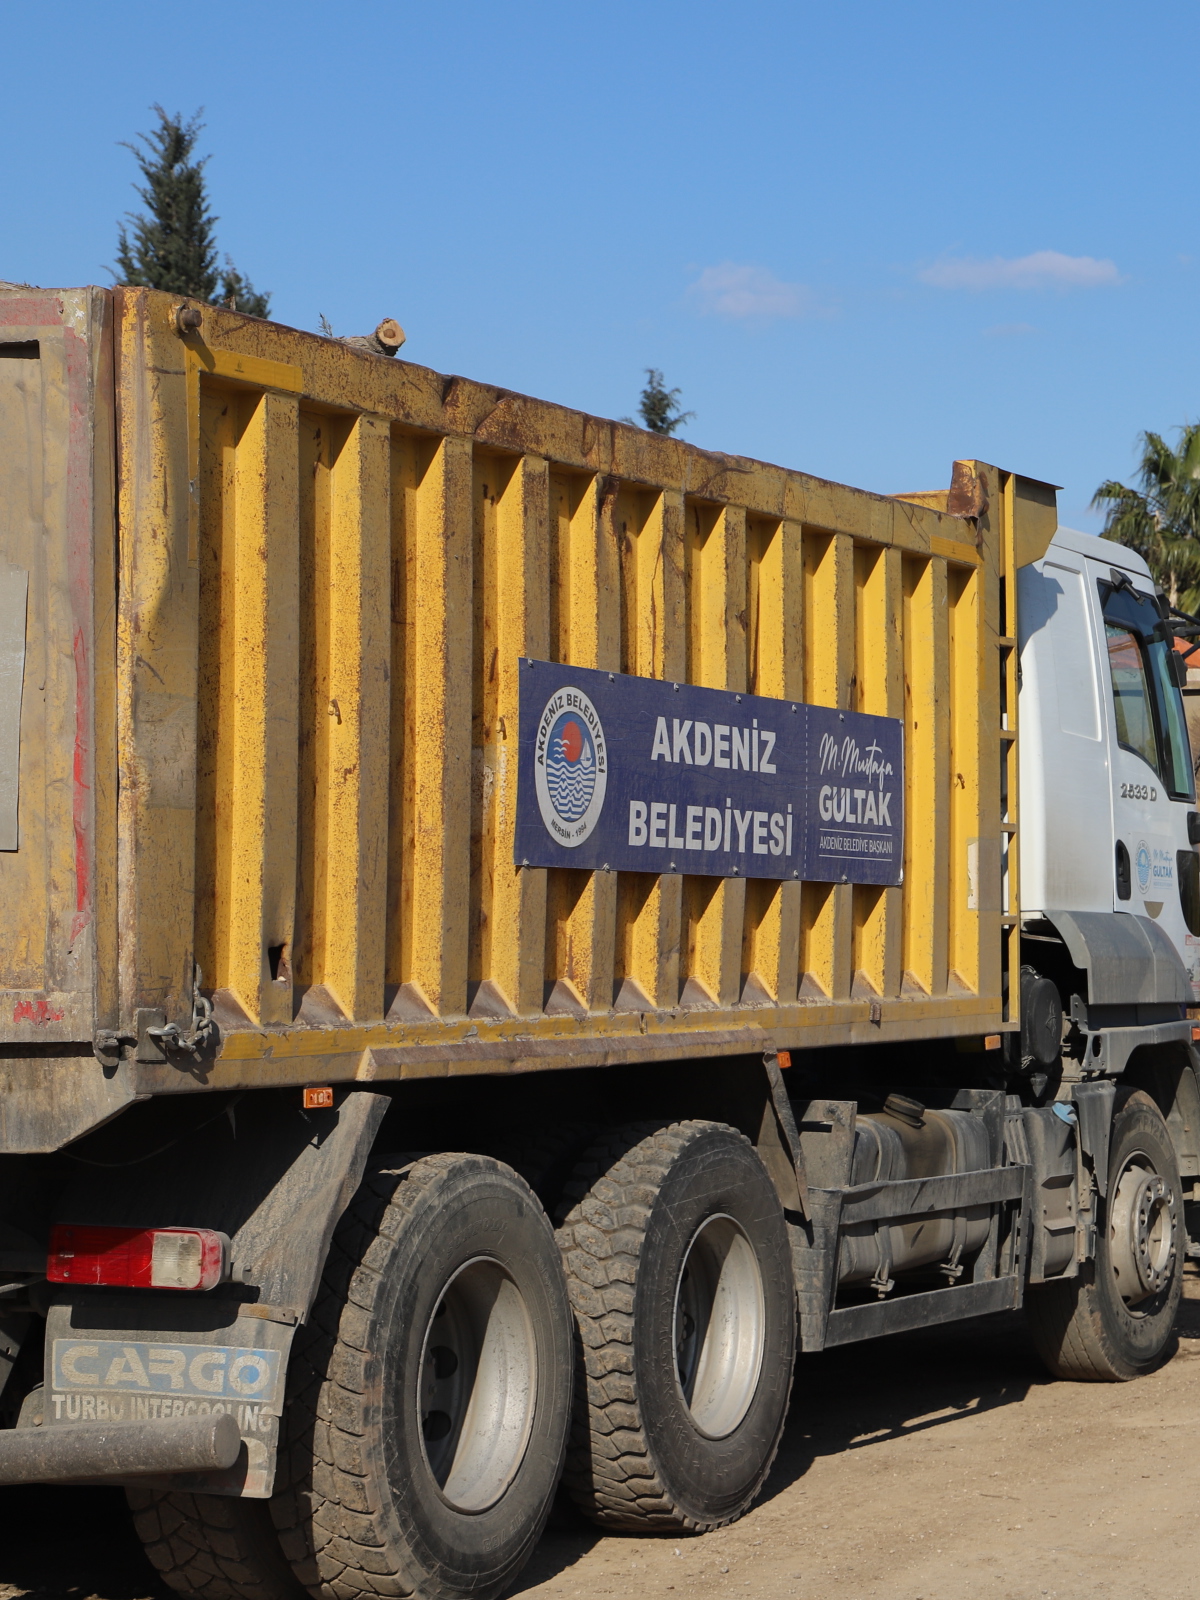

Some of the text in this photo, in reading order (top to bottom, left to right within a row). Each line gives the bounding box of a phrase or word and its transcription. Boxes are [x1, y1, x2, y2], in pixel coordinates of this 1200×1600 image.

[537, 694, 565, 766] AKDENİZ
[651, 716, 777, 774] AKDENİZ
[819, 785, 892, 827] GÜLTAK
[1120, 783, 1148, 800] 2533
[628, 797, 793, 856] BELEDİYESİ
[820, 836, 843, 850] AKDENİZ
[61, 1345, 270, 1395] CARGO
[51, 1394, 124, 1420] TURBO
